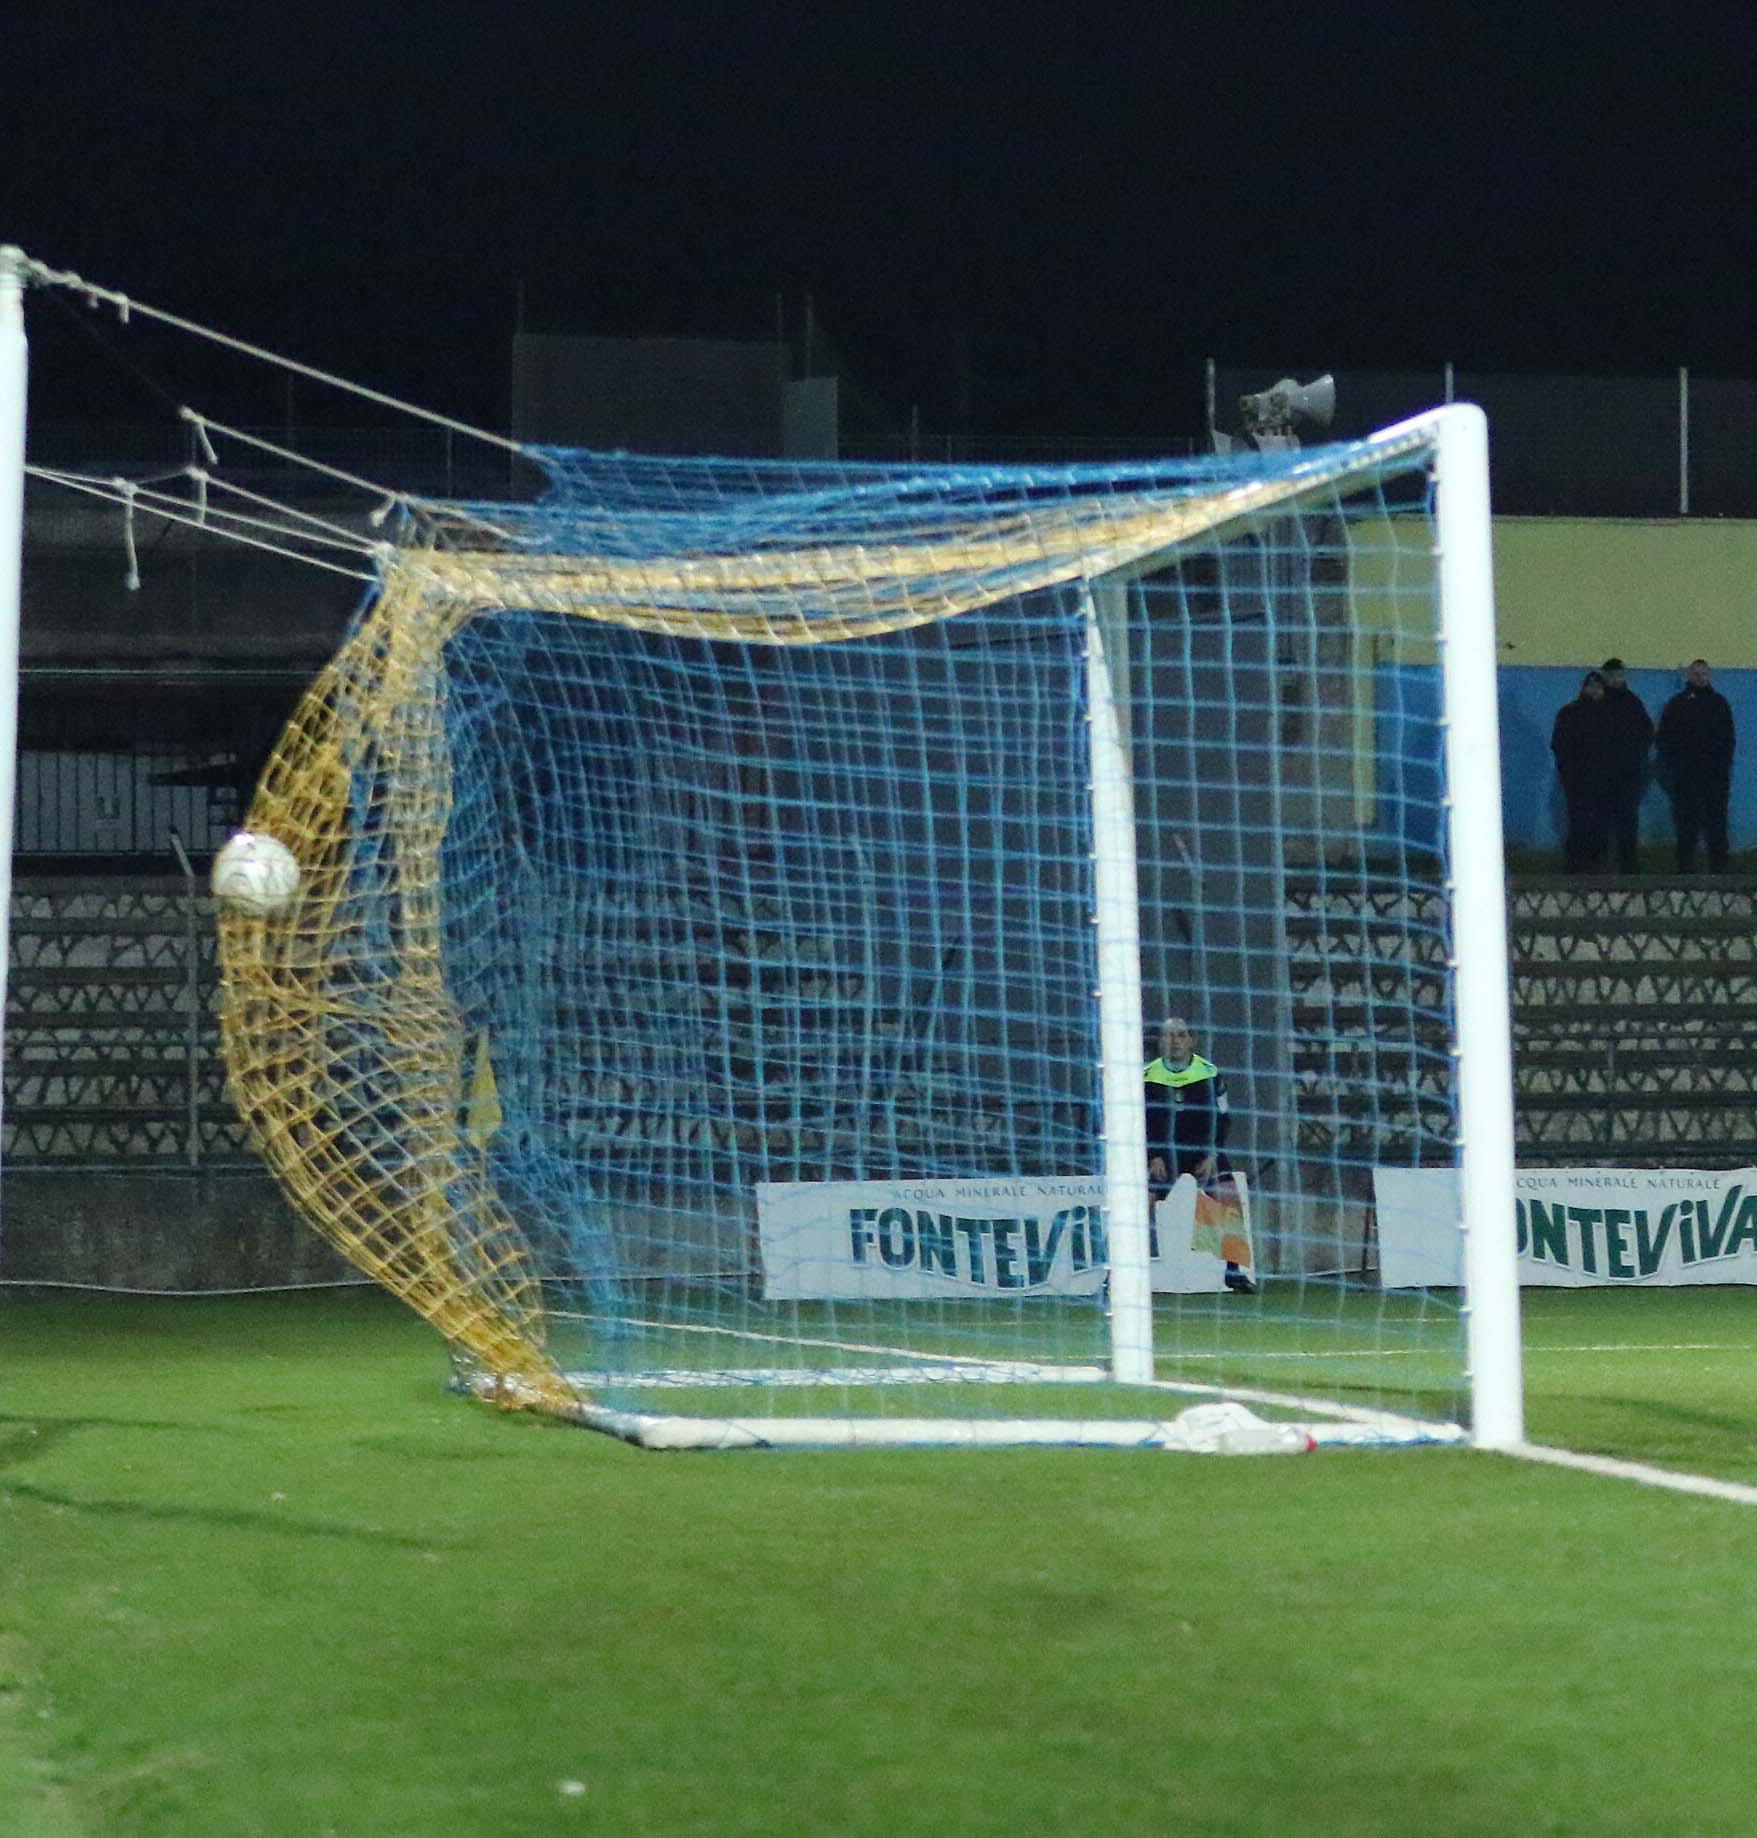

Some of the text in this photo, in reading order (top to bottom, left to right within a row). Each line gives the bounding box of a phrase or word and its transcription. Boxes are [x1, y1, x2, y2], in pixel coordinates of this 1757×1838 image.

[1516, 1177, 1721, 1190] CQUA MINERALE NATURALE
[955, 1185, 1026, 1198] MINERALE
[1037, 1184, 1104, 1197] NATURAL
